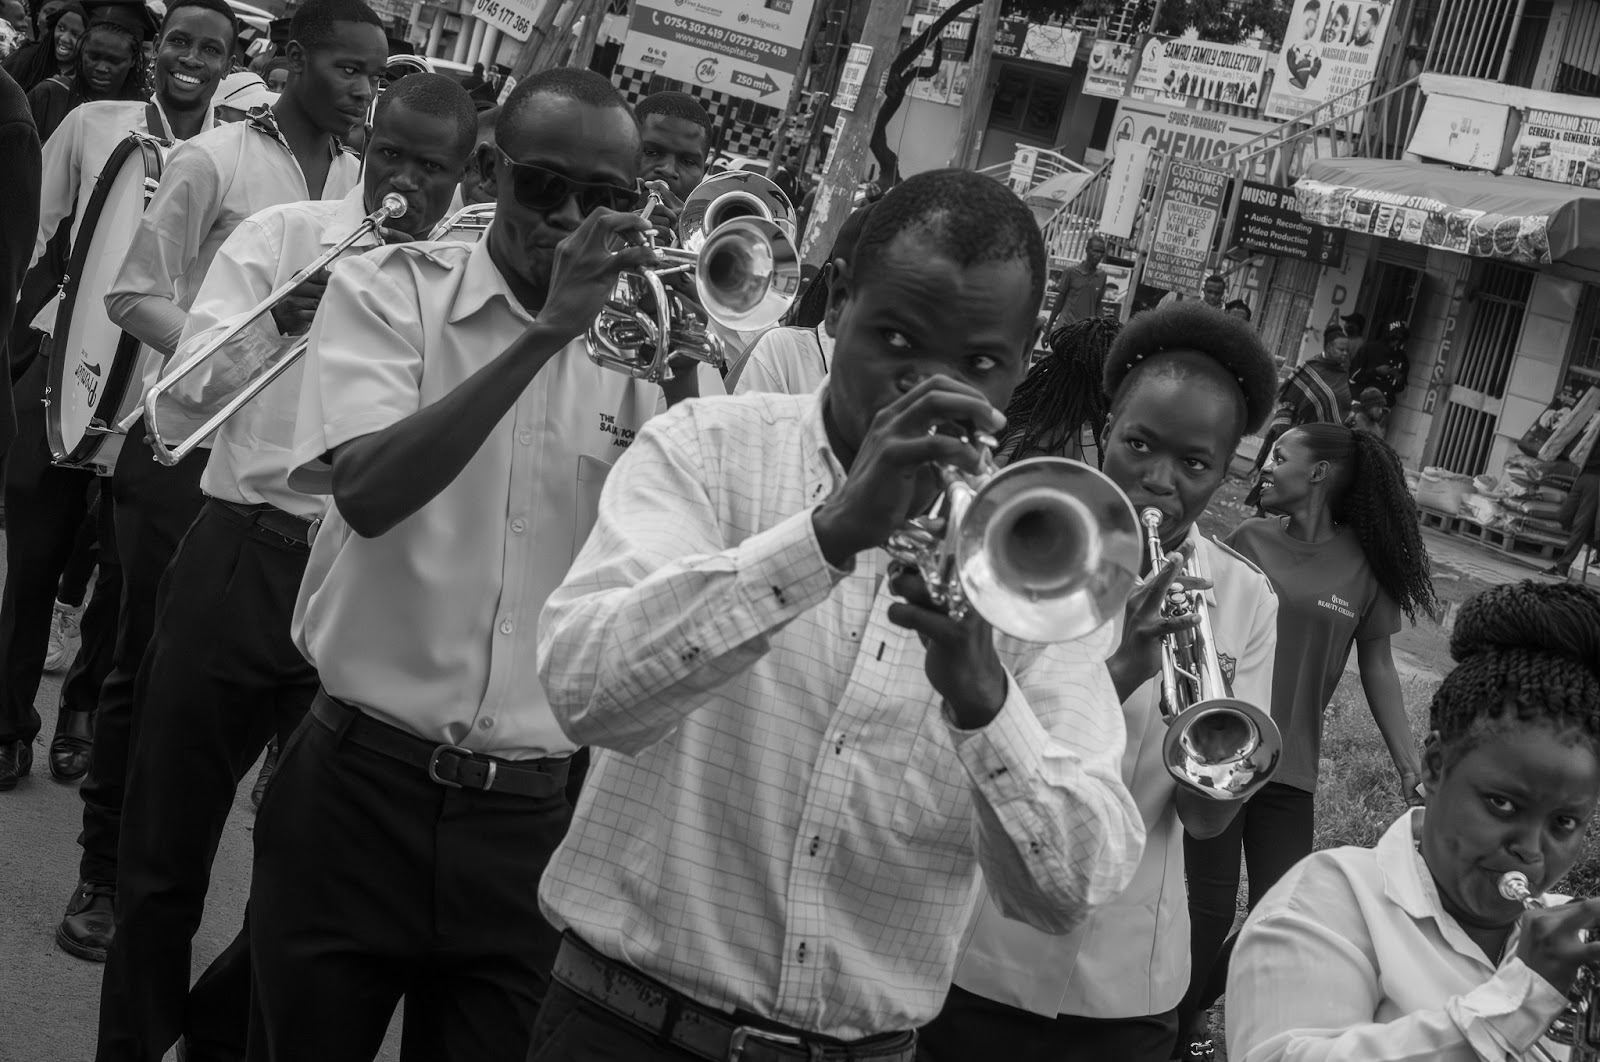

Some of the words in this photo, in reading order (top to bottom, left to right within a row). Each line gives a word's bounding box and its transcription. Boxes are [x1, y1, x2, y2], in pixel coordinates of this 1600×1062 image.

[774, 0, 791, 11] KCB
[477, 0, 499, 17] 0745
[498, 7, 515, 25] 177
[512, 15, 530, 34] 366
[663, 15, 688, 30] 0754
[688, 23, 706, 36] 302
[707, 27, 724, 39] 419
[729, 32, 753, 48] 0727
[752, 41, 771, 53] 302
[771, 45, 788, 58] 419
[675, 32, 760, 62] www.wamahospital.org
[1189, 46, 1218, 66] FAMILY
[1216, 50, 1263, 74] COLLECTION
[1348, 51, 1369, 64] CHAIR
[736, 74, 752, 86] 250
[752, 80, 774, 92] mtrs
[1331, 75, 1349, 86] HAIR
[1353, 68, 1372, 80] CUTS
[1168, 111, 1190, 128] SPURS
[1190, 115, 1228, 134] PHARMACY
[1528, 110, 1580, 131] MAGOMANO
[1528, 126, 1556, 139] CEREALS
[1562, 131, 1591, 145] GENERAL
[1172, 165, 1225, 187] CUSTOMER
[1172, 177, 1219, 198] PARKING
[1174, 189, 1205, 206] ONLY
[1241, 186, 1278, 208] MUSIC
[1352, 188, 1410, 206] MAGOMANO
[1406, 195, 1447, 212] STORES
[1166, 222, 1185, 236] WILL
[1188, 227, 1200, 238] BE
[1168, 213, 1206, 230] VEHICLES
[1250, 213, 1273, 225] Audio
[1276, 218, 1313, 235] Recording
[1162, 231, 1187, 246] TOWED
[1190, 238, 1200, 248] AT
[1248, 225, 1269, 237] Video
[1270, 230, 1309, 246] Production
[1245, 237, 1268, 249] Music
[1269, 242, 1308, 258] Marketing
[1156, 253, 1200, 270] DRIVEWAY
[1157, 262, 1169, 272] NOT
[1154, 271, 1186, 287] CONSTANT
[1186, 279, 1199, 289] USE
[599, 413, 615, 424] THE
[1317, 600, 1338, 611] BEAUTY
